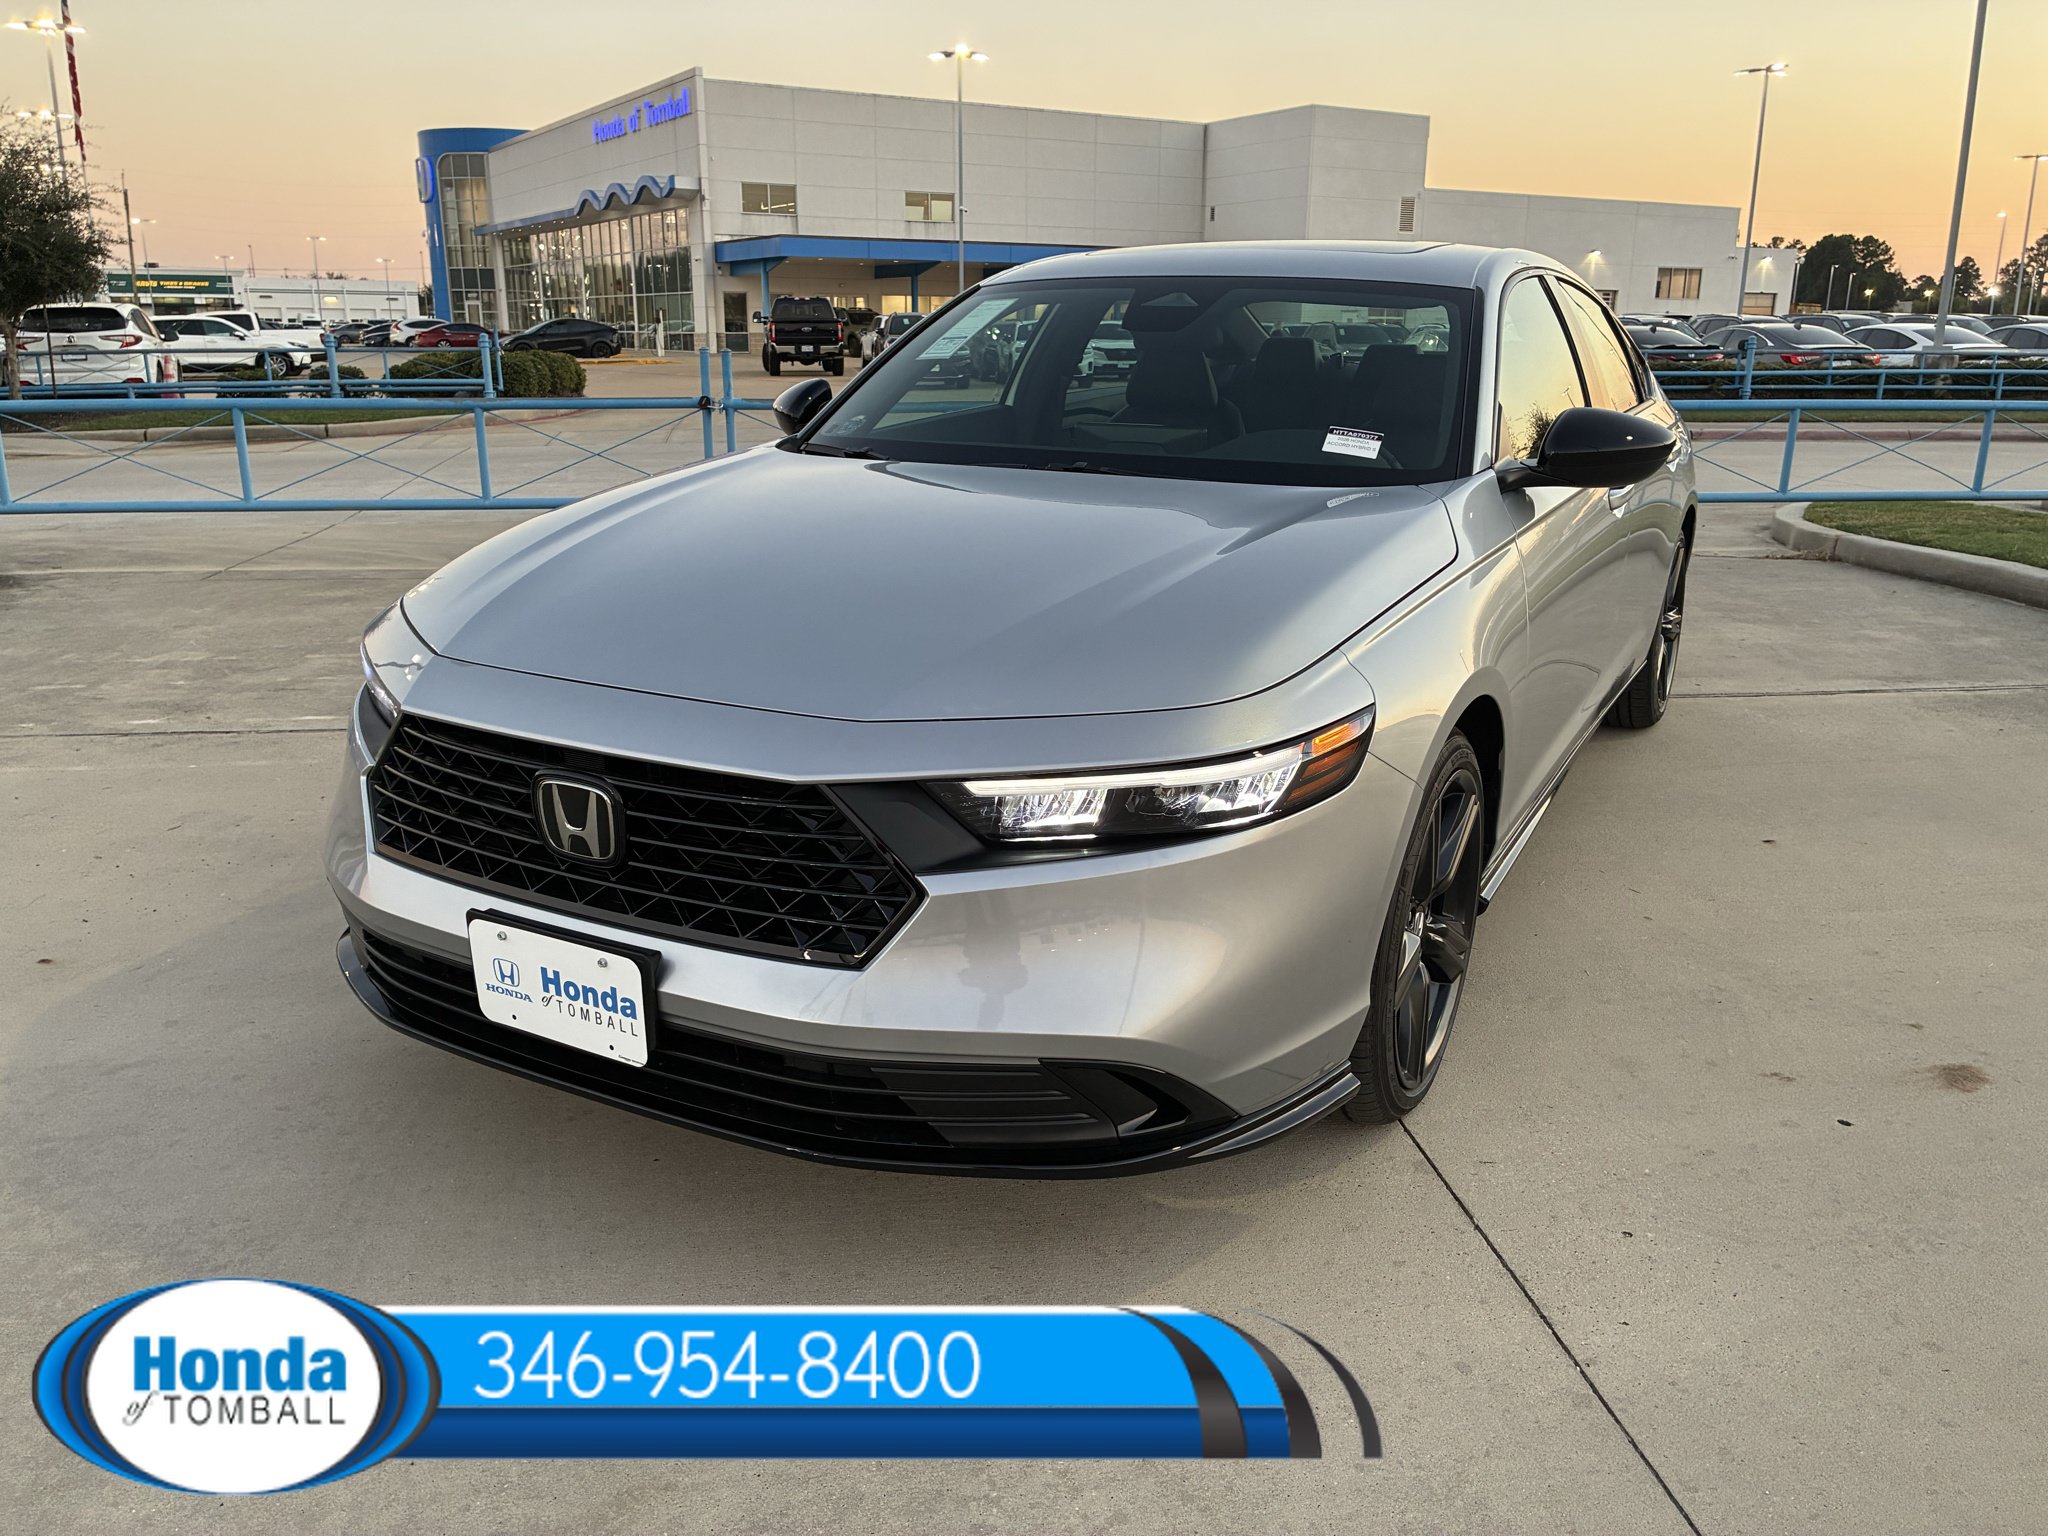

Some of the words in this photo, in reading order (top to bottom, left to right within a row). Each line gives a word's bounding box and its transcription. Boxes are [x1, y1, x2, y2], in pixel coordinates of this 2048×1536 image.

[592, 113, 625, 143] Honda
[628, 105, 639, 133] of
[643, 86, 690, 127] Tomball
[485, 982, 533, 1004] HONDA
[540, 966, 638, 1021] Honda
[541, 994, 554, 1007] of
[556, 999, 638, 1037] TOMBALL
